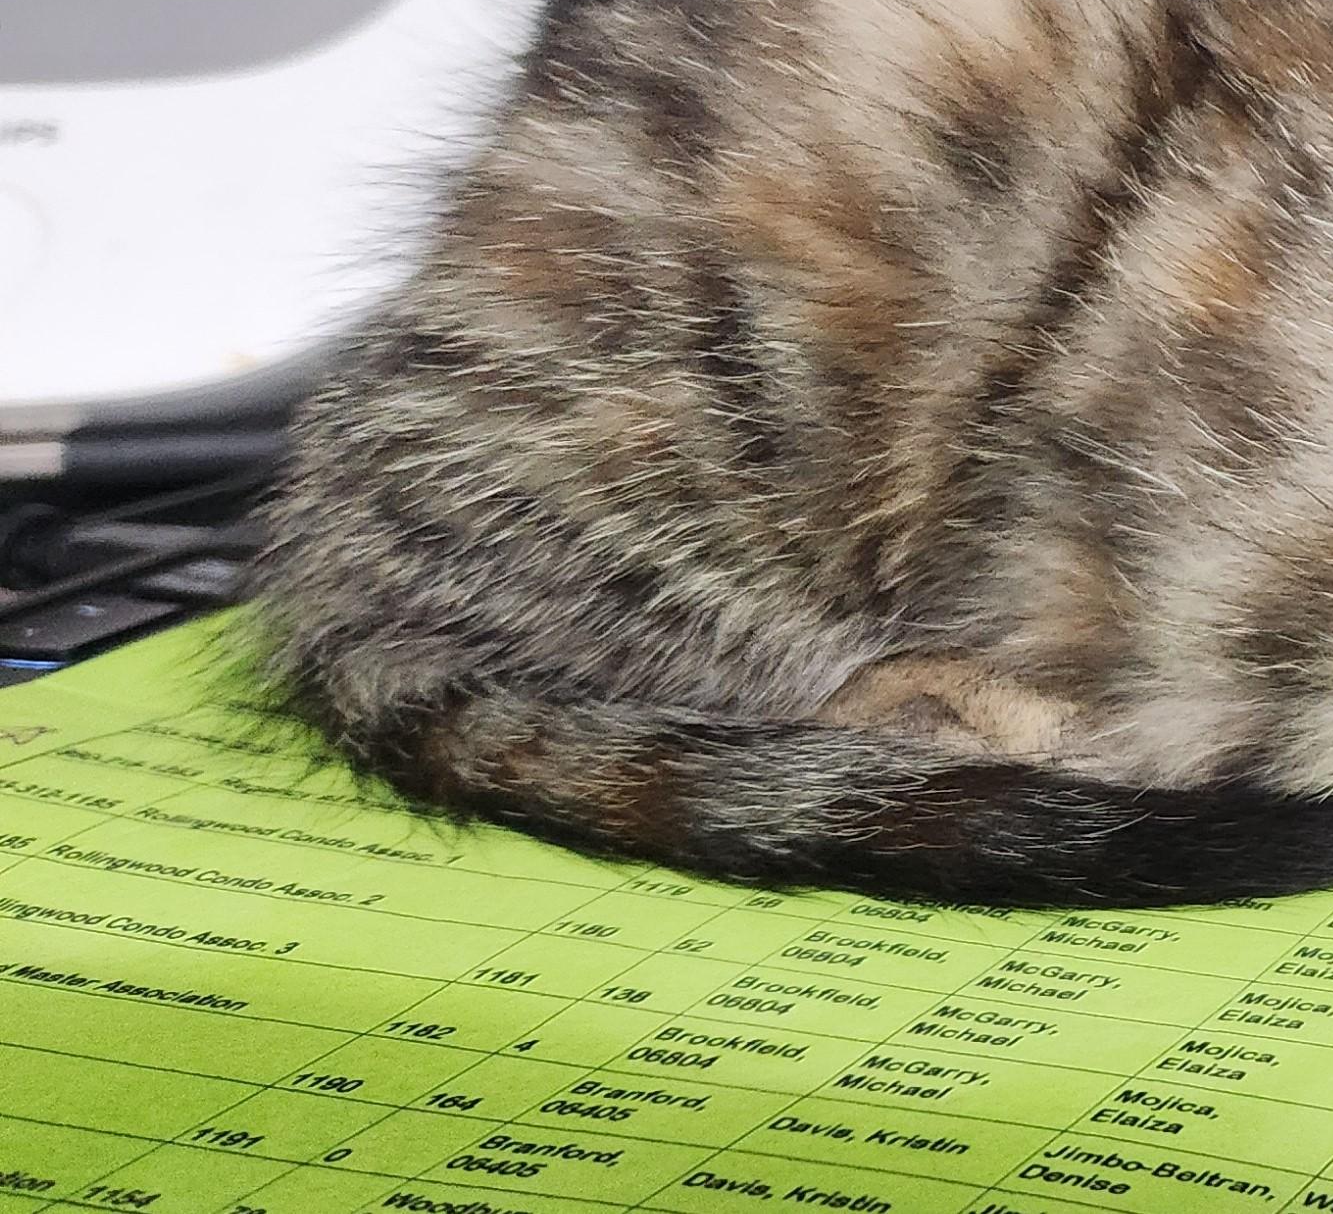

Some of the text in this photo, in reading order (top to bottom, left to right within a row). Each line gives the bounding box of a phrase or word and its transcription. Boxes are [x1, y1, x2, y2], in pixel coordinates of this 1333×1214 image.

[135, 806, 281, 837] Rollingwood
[279, 828, 355, 850] Condo
[356, 842, 435, 863] Assoc.
[46, 843, 387, 907] Rollingwood Condo Assoc. 2
[0, 897, 300, 955] llingwood Condo Assoc. 3
[555, 919, 622, 937] 1180
[850, 904, 935, 924] 06804
[1060, 914, 1182, 942] McGarry,
[803, 929, 951, 964] Brookfield,
[1038, 930, 1149, 954] Michael
[780, 945, 867, 968] 06804
[10, 965, 102, 991] Master
[96, 979, 250, 1012] Association
[472, 967, 541, 986] 1181
[975, 975, 1090, 1002] Michael
[998, 959, 1122, 990] McGarry,
[706, 993, 796, 1016] 06804
[731, 975, 882, 1011] Brookfield,
[384, 1020, 458, 1040] 1182
[931, 1005, 1060, 1036] McGarry,
[1217, 1008, 1305, 1031] Elaiza
[513, 1039, 541, 1053] 4
[653, 1026, 811, 1062] Brookfield,
[906, 1021, 1025, 1048] Michael
[626, 1046, 721, 1069] 06804
[1178, 1039, 1282, 1068] Mojica,
[290, 1072, 365, 1093] 1190
[859, 1054, 992, 1086] McGarry,
[1155, 1056, 1248, 1082] Elaiza
[568, 1079, 713, 1112] Branford,
[832, 1073, 955, 1101] Michael
[538, 1100, 640, 1122] 06405
[1113, 1089, 1220, 1120] Mojica,
[766, 1115, 971, 1156] Davis, Kristin
[1090, 1107, 1185, 1136] Elaiza
[191, 1126, 266, 1149] 1191
[477, 1135, 626, 1167] Branford,
[446, 1154, 548, 1177] 06405
[1017, 1162, 1133, 1196] Denise
[1043, 1144, 1278, 1203] Jimbo-Beltran,
[681, 1171, 893, 1214] Davis, Kristin
